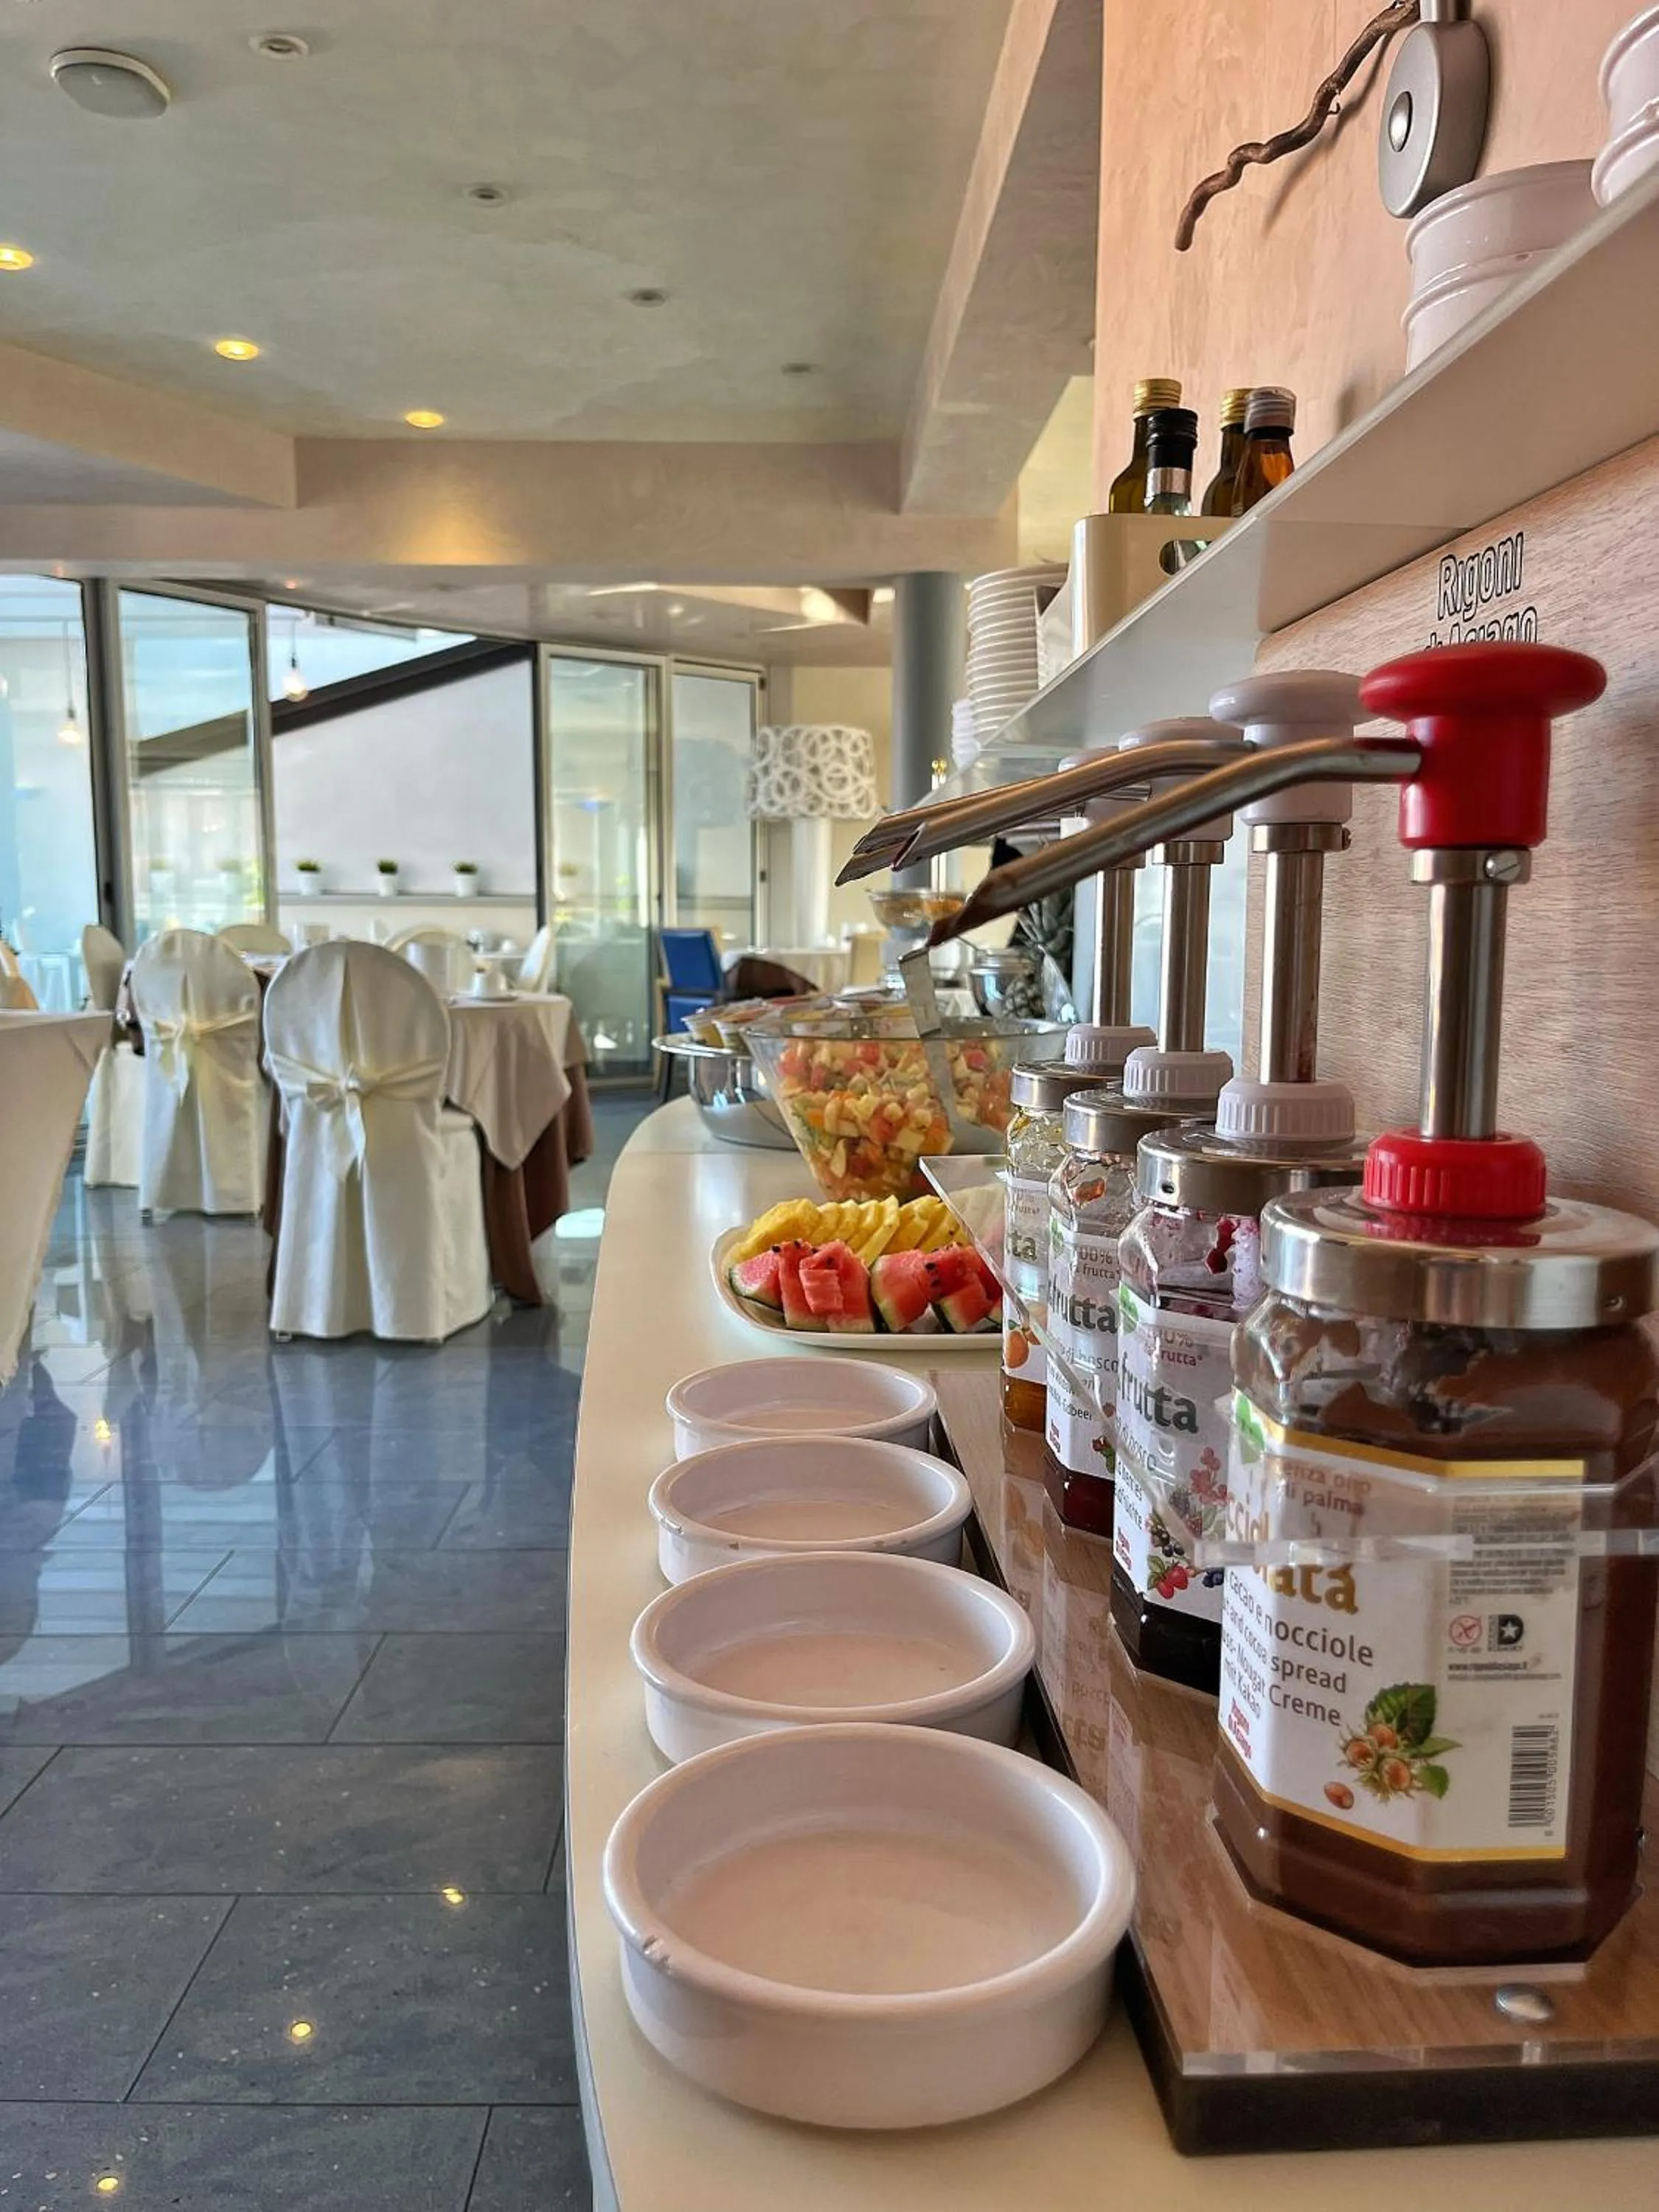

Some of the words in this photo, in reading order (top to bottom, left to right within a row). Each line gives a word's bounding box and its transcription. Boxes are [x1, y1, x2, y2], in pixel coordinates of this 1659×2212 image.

[1437, 532, 1524, 622] Rigoni
[1048, 1274, 1118, 1334] frutta
[1119, 1351, 1199, 1434] frutta
[1276, 1458, 1326, 1484] enza
[1304, 1489, 1365, 1515] palma
[1229, 1569, 1254, 1613] cacao
[1256, 1601, 1262, 1624] e
[1264, 1613, 1374, 1667] nocciole
[1271, 1655, 1346, 1694] spread
[1269, 1684, 1341, 1727] Creme
